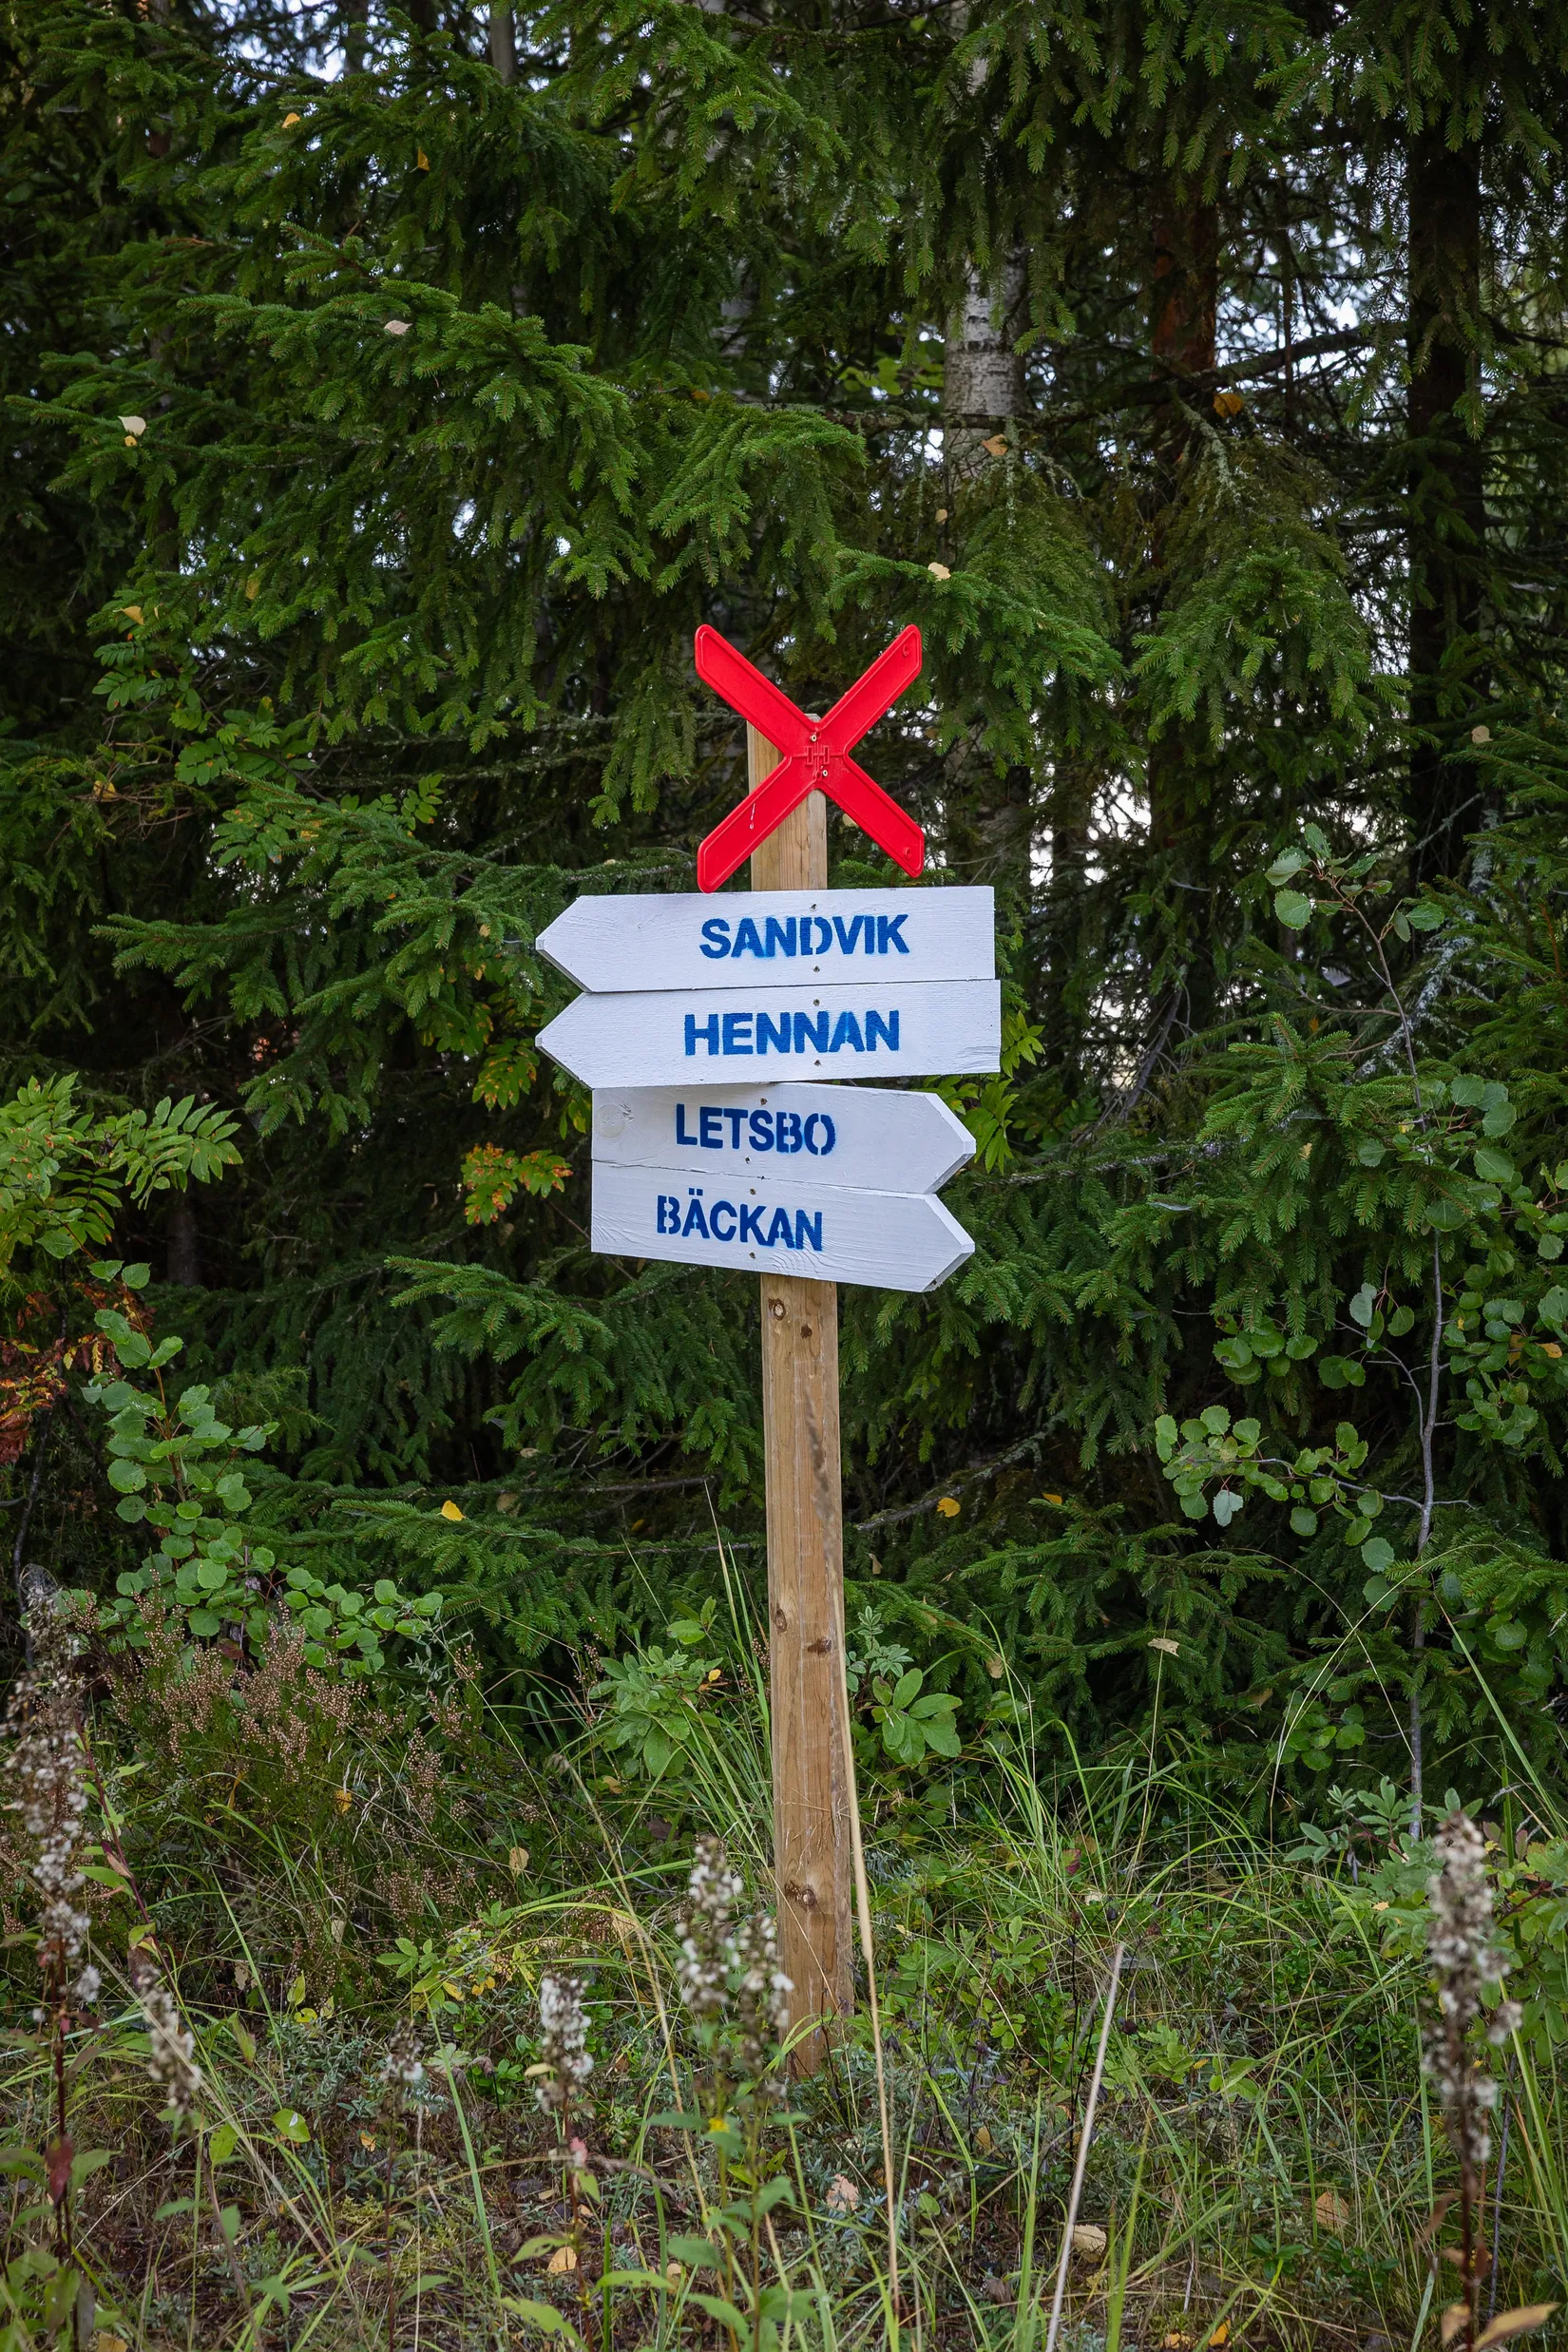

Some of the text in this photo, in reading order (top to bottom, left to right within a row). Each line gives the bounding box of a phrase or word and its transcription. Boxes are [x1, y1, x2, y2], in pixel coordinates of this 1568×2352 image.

[699, 914, 909, 959] SANDVIK
[684, 1010, 900, 1056] HENNAN
[676, 1103, 836, 1157] LETSBO
[657, 1188, 824, 1252] BÄCKAN
